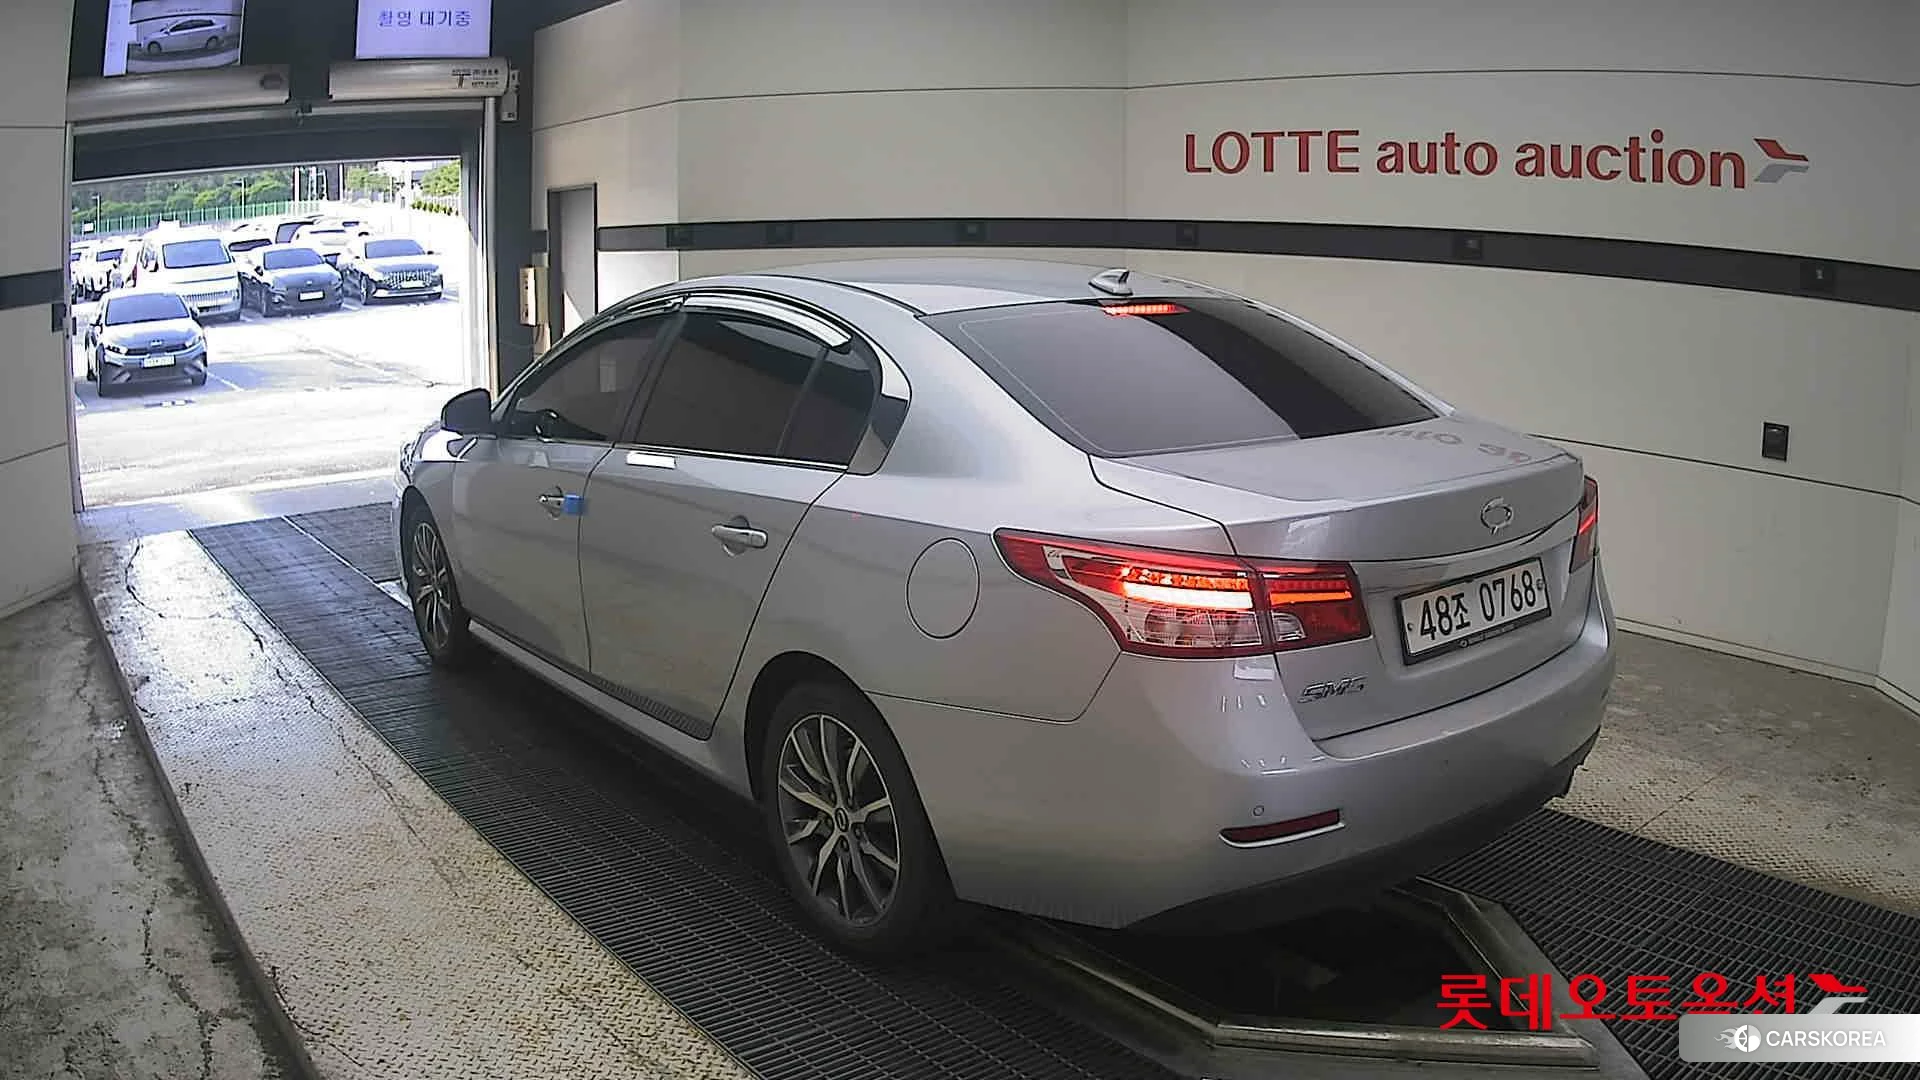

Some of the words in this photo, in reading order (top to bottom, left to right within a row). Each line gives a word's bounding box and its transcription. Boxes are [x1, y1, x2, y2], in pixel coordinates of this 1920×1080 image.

[420, 10, 471, 28] 대기중
[1185, 129, 1361, 173] LOTTE
[1376, 132, 1499, 177] auto
[1514, 129, 1746, 188] auction
[1420, 592, 1471, 641] 48조
[1479, 570, 1536, 622] 0768
